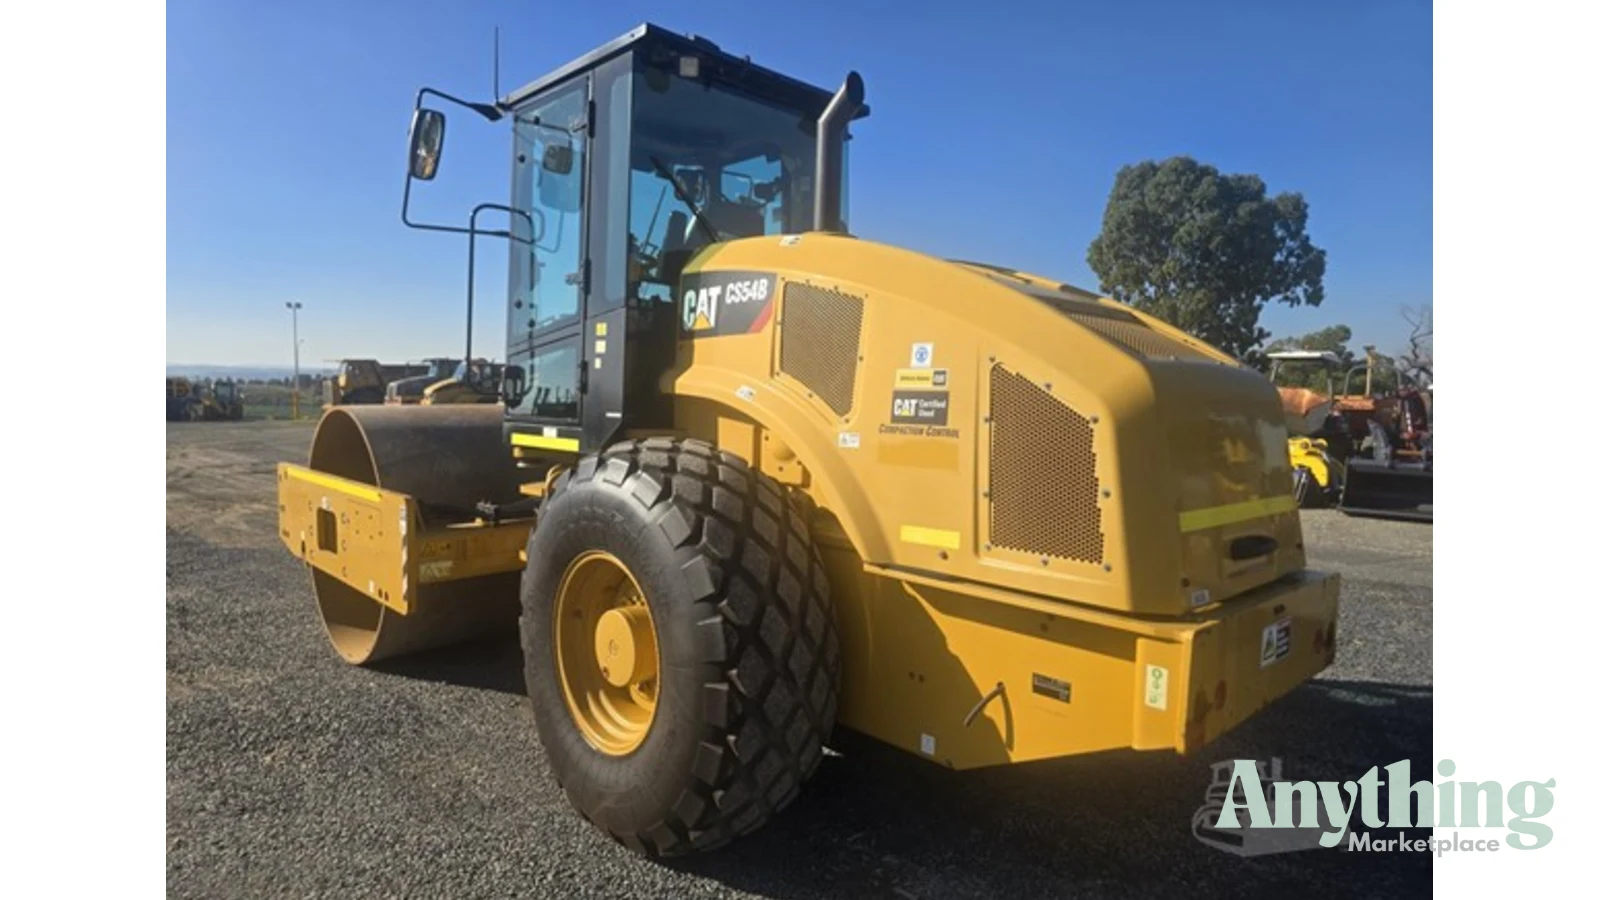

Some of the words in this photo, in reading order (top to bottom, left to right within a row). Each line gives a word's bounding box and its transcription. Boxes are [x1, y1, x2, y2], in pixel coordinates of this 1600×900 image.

[683, 285, 722, 330] CAT
[725, 278, 768, 304] CS54B
[893, 398, 918, 416] CAT
